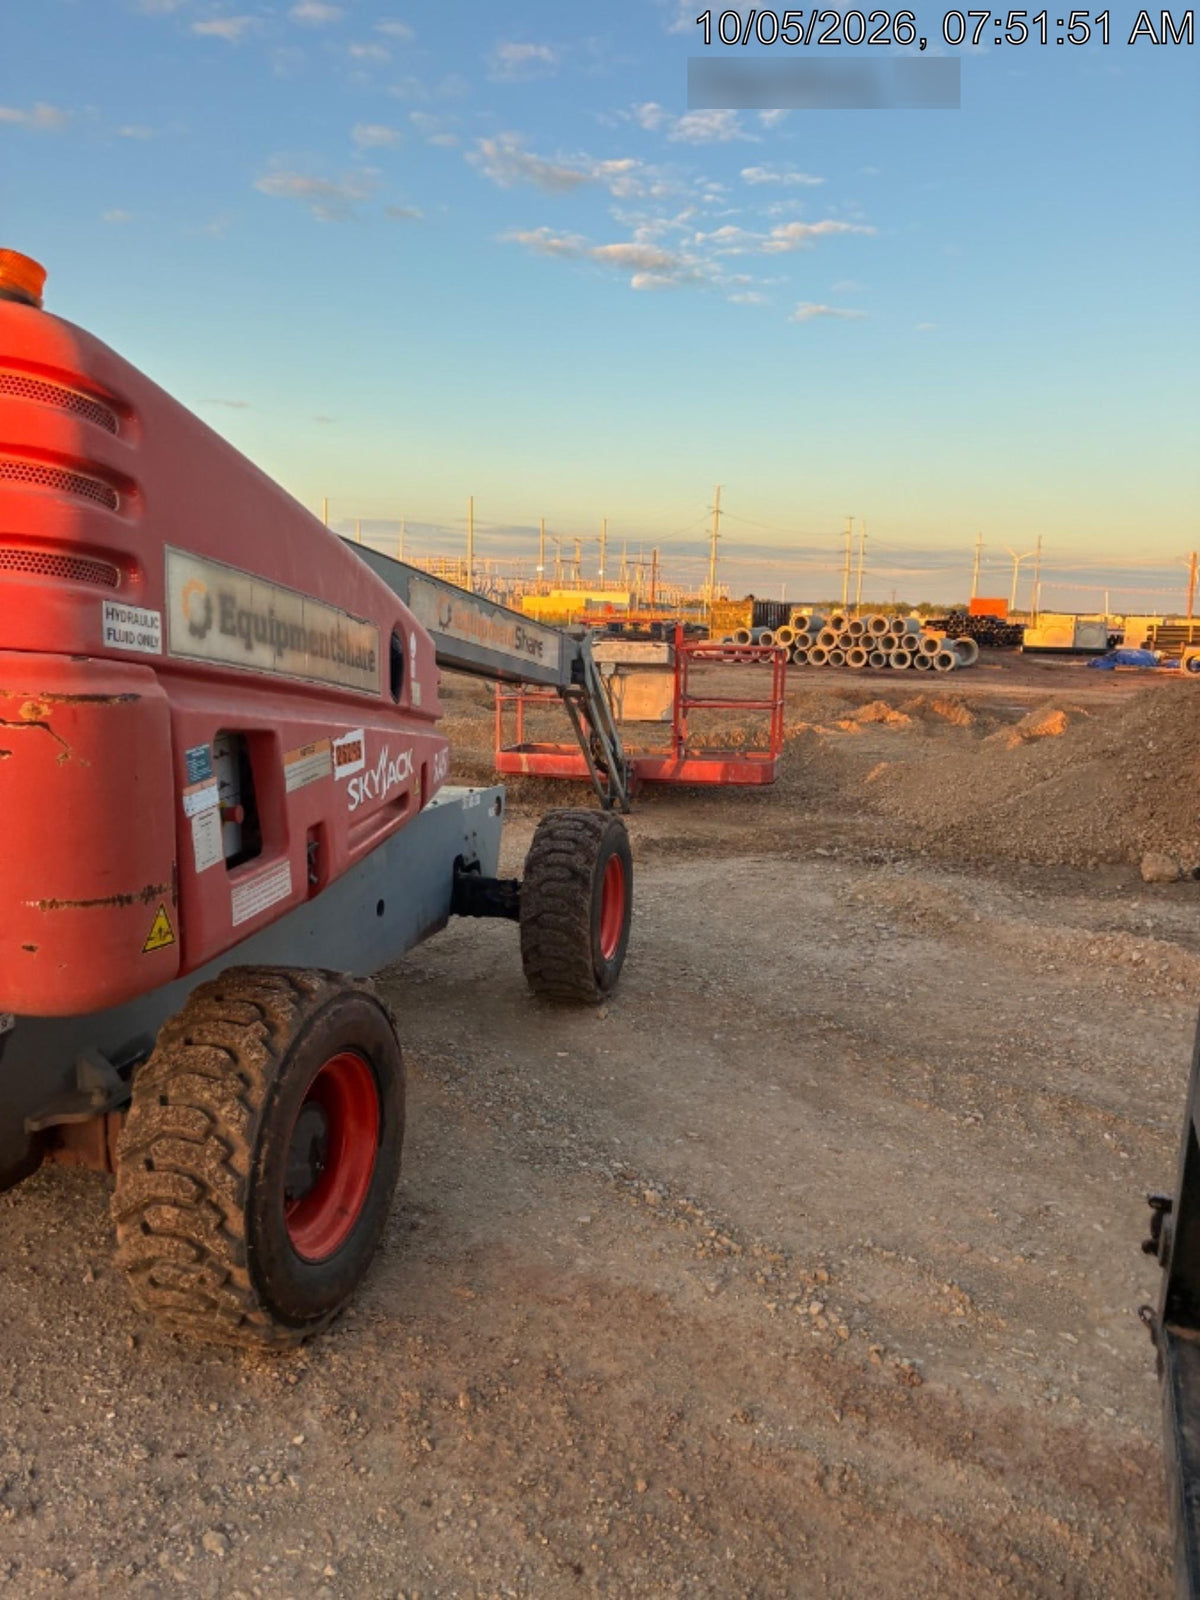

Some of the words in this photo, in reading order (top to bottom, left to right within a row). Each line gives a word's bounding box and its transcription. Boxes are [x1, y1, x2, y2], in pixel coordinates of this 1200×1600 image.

[105, 606, 159, 630] HYDRAULIC
[106, 627, 136, 645] FLUID
[137, 632, 159, 649] ONLY
[347, 744, 414, 812] SKYJACK
